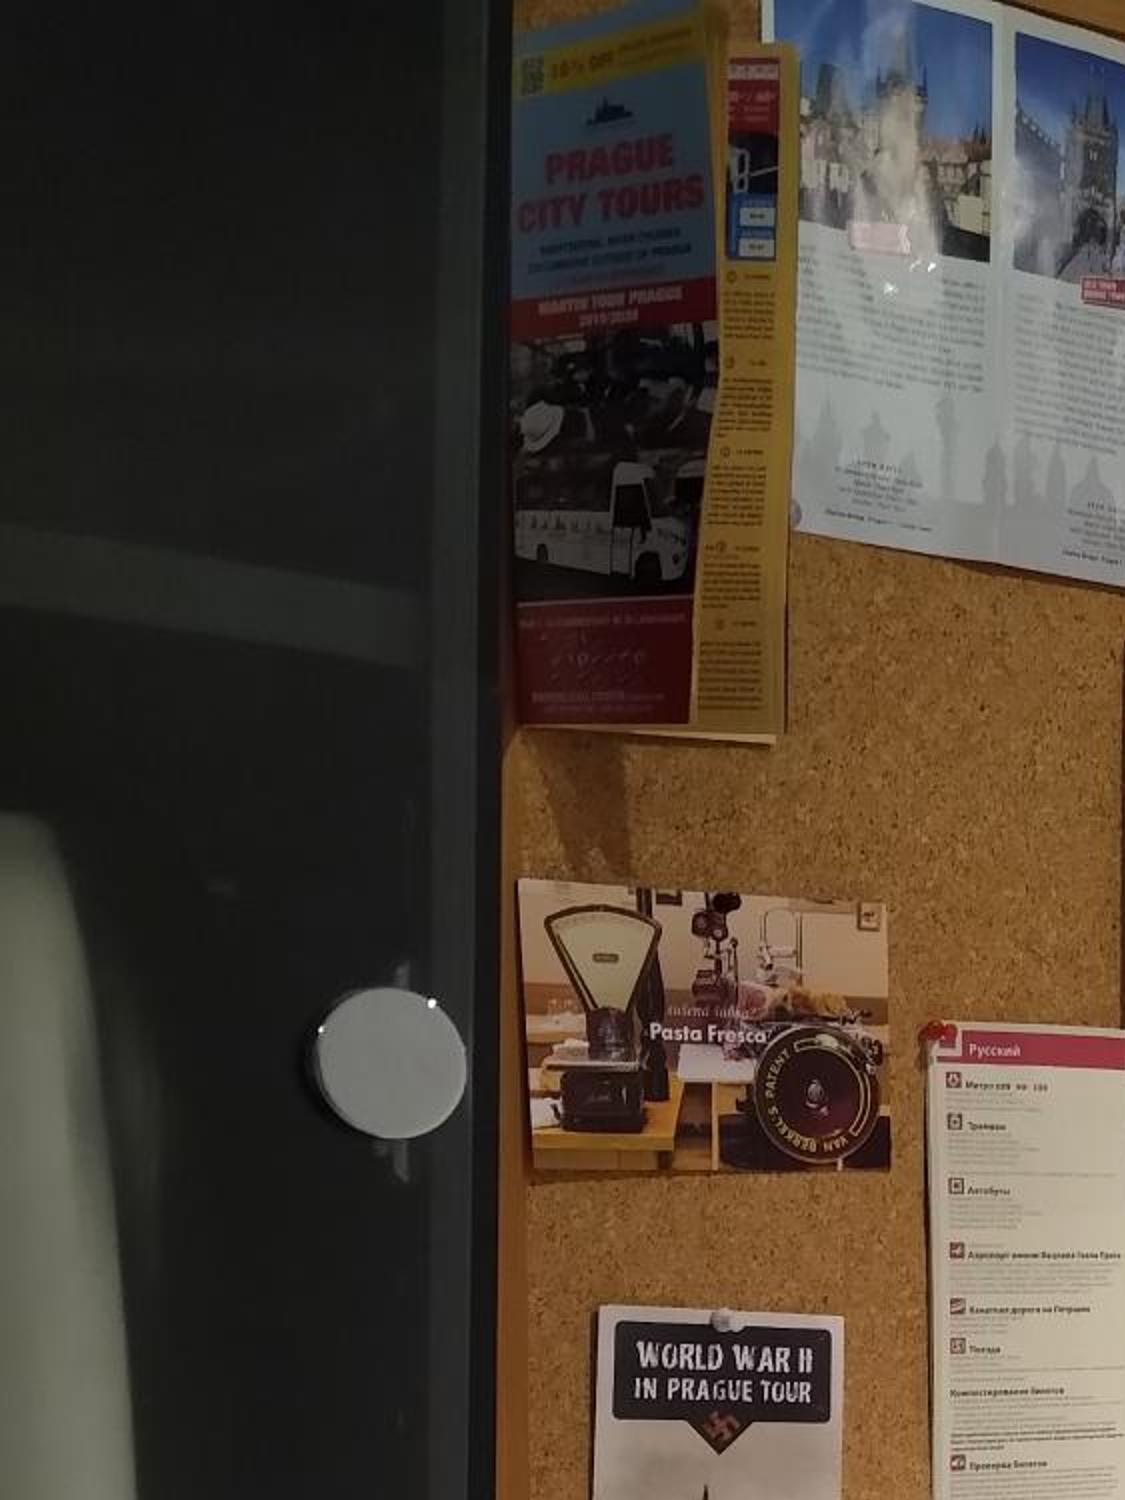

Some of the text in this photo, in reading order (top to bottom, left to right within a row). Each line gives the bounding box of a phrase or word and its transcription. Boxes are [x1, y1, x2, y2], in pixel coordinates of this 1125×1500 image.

[545, 133, 675, 185] PRAGUE
[518, 173, 706, 234] CITY TOURS
[649, 1023, 767, 1046] Pasta Fresca
[968, 1043, 1022, 1060] Русский
[636, 1341, 724, 1371] WORLD
[733, 1346, 792, 1374] WAR
[635, 1377, 812, 1404] IN PRAGUE TOUR
